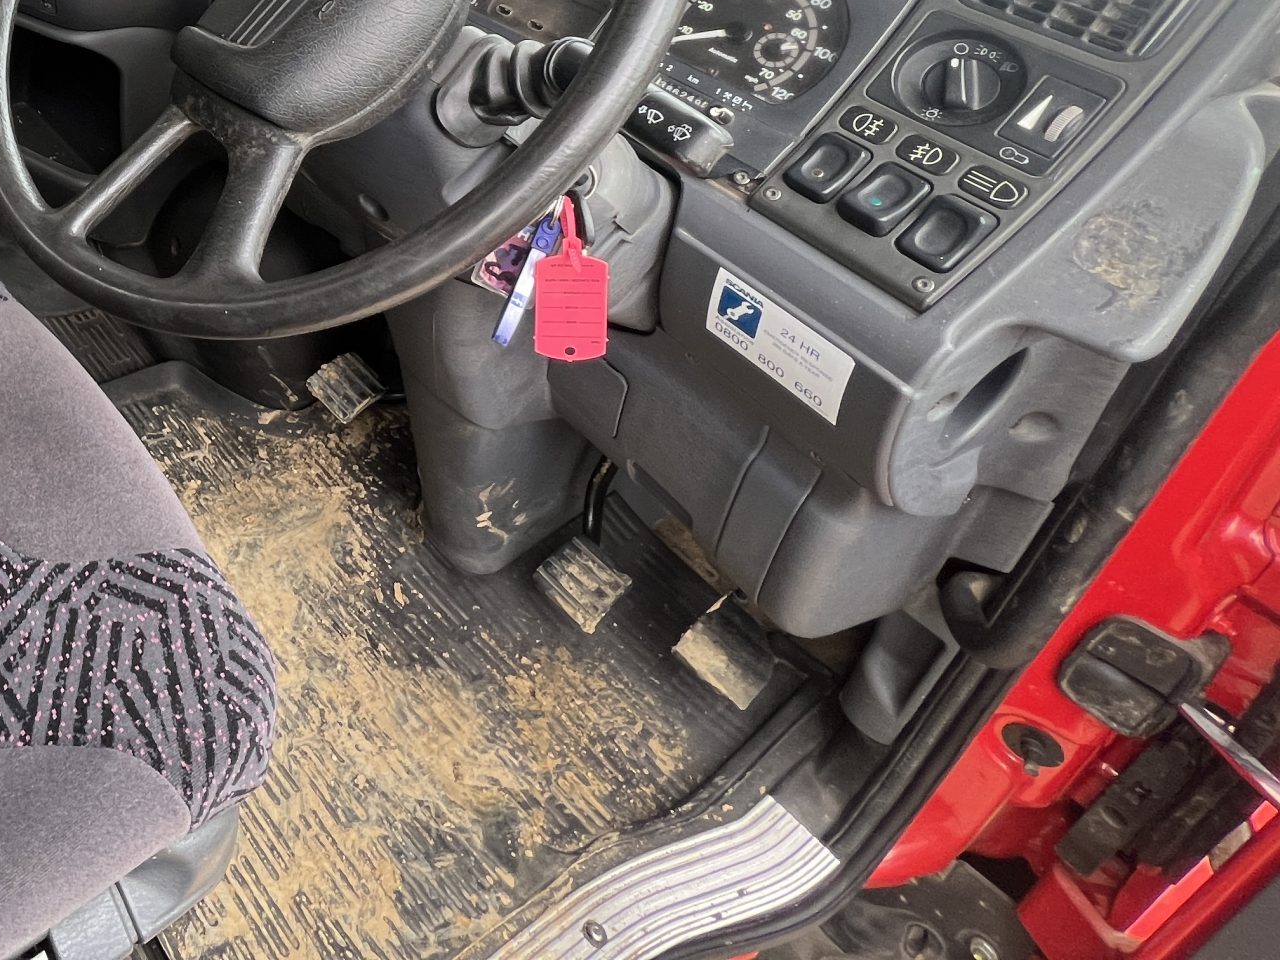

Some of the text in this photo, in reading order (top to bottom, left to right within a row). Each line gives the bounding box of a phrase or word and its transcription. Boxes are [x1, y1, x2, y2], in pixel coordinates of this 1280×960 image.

[699, 1, 714, 12] 20
[785, 9, 803, 21] 50
[790, 28, 808, 39] 60
[687, 74, 700, 85] km
[758, 68, 775, 80] 70
[725, 278, 764, 308] SCANIA
[780, 328, 821, 361] 24 HR
[714, 322, 823, 407] 0800 800 660
